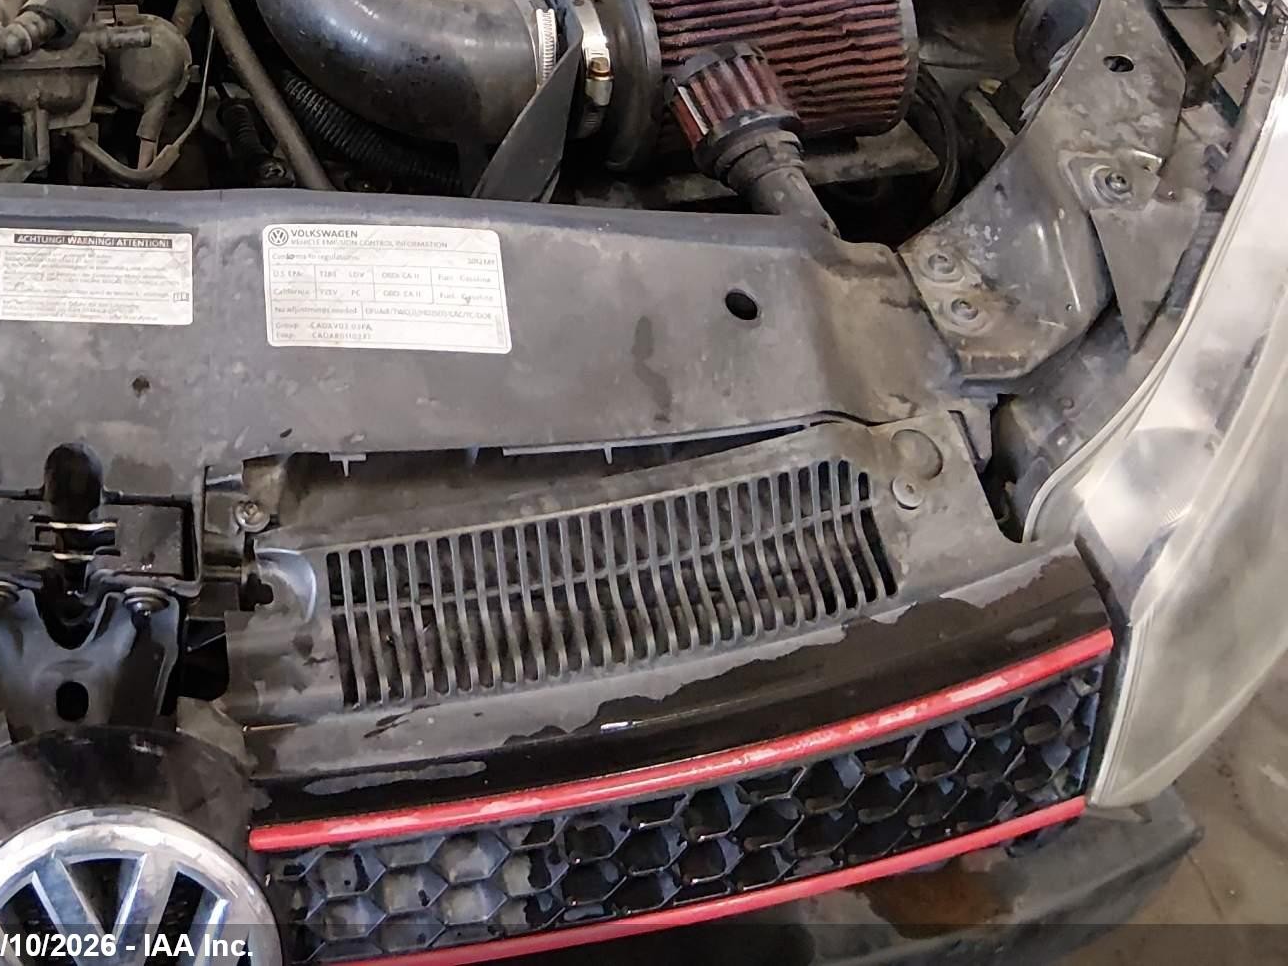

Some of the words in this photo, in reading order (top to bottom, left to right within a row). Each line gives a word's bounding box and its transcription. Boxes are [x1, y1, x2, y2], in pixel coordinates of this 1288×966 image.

[291, 229, 358, 239] VOLKSWAGEN
[17, 235, 65, 244] ACHTUNG!
[67, 236, 115, 246] WARNING!
[116, 237, 170, 248] ATTENTION!
